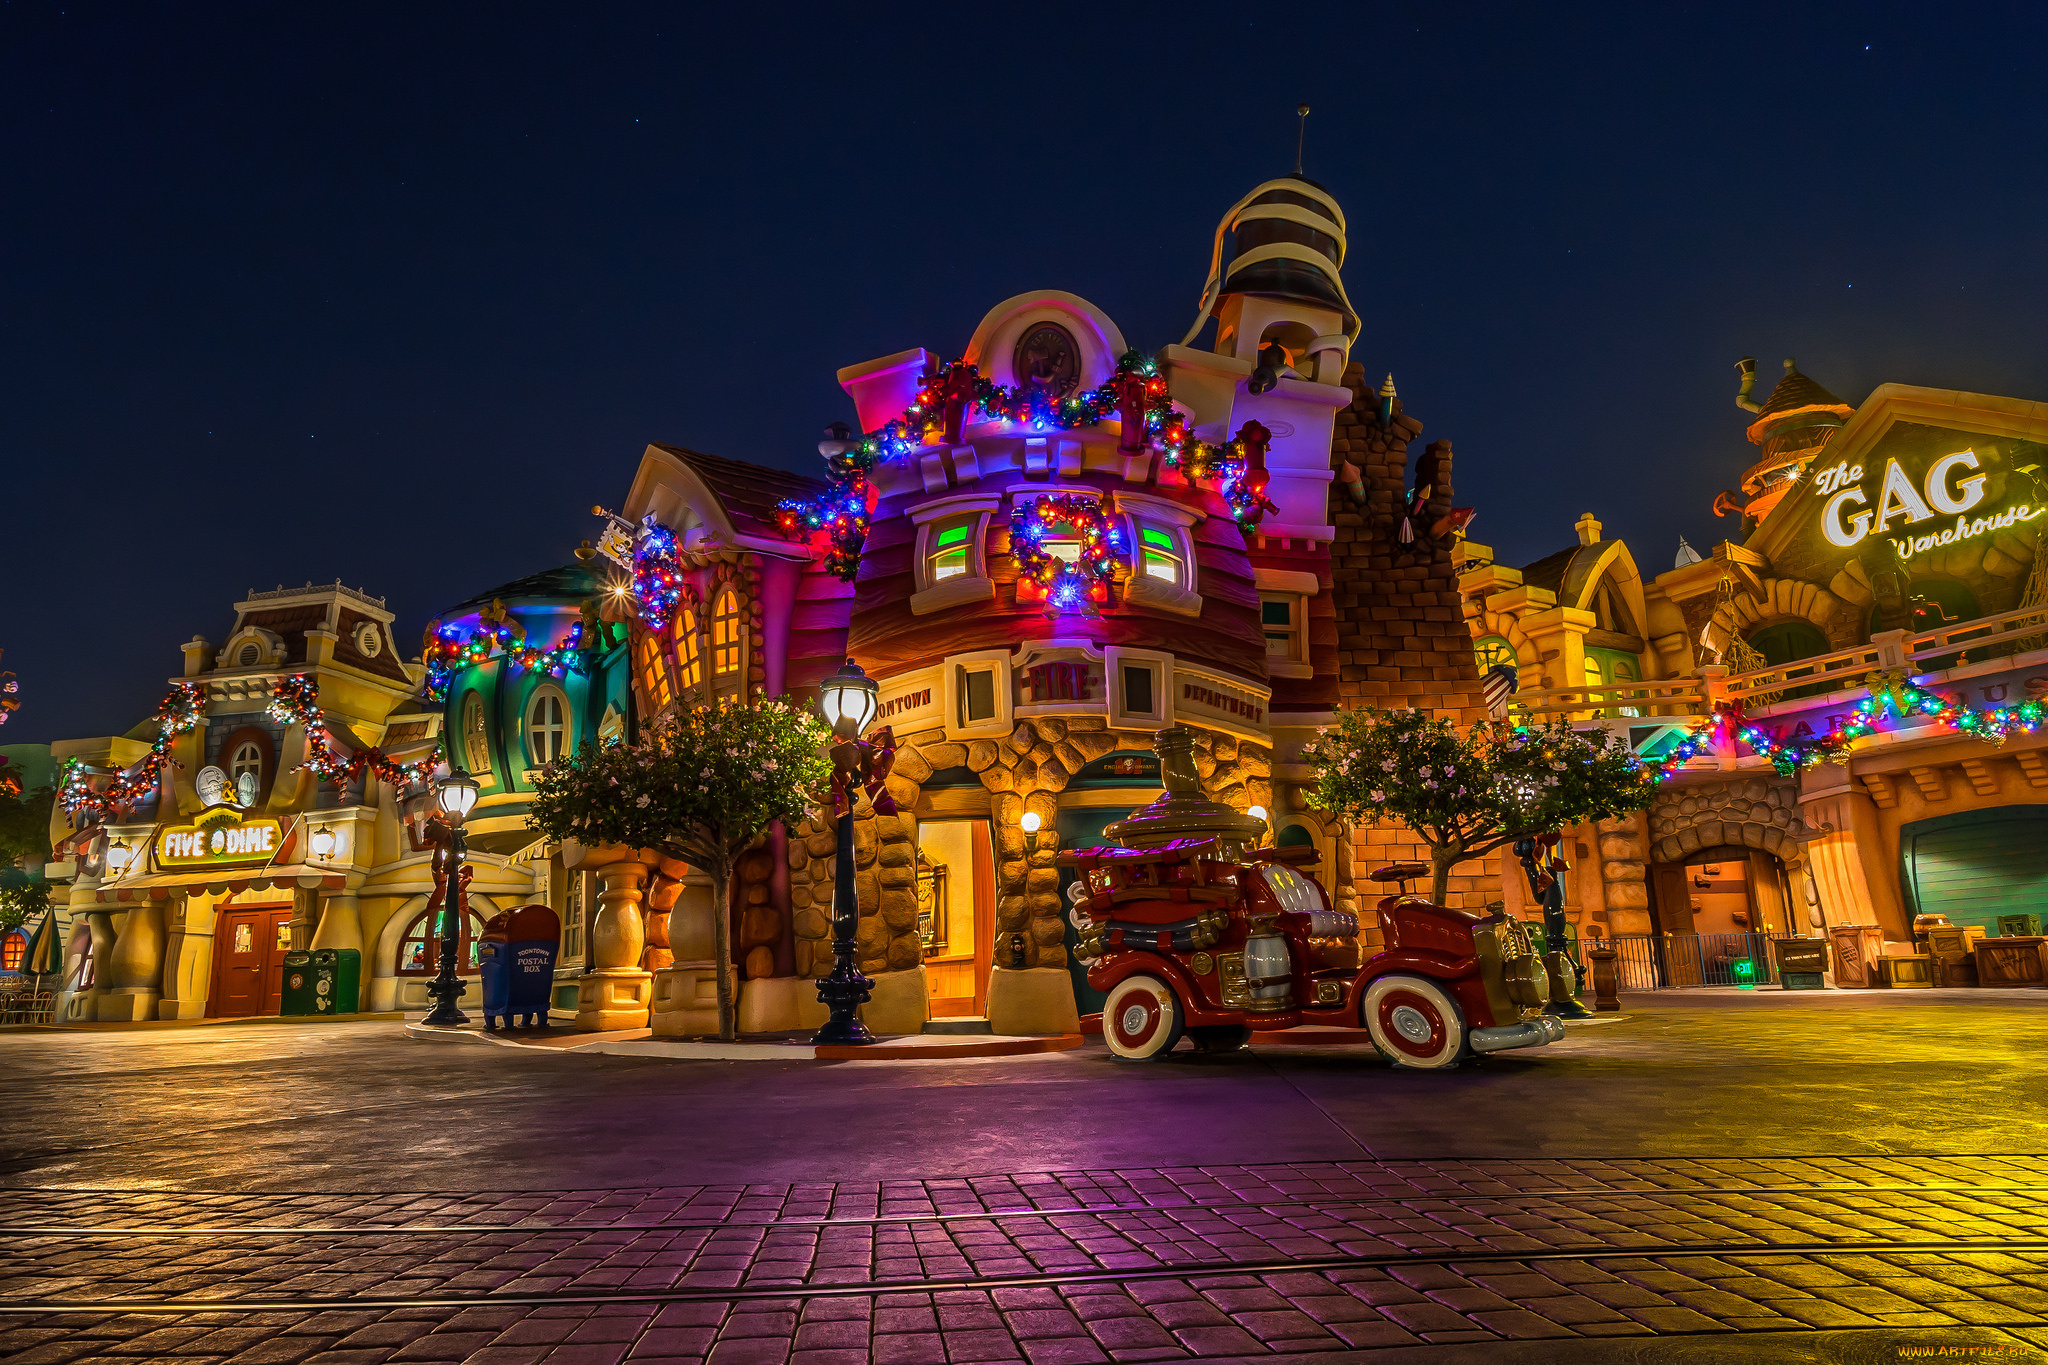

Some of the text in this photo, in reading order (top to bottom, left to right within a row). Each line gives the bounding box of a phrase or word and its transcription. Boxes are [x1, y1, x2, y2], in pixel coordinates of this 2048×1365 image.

[1815, 460, 1864, 495] The
[1821, 447, 1987, 547] GAG
[1887, 504, 2046, 559] Warehouse
[872, 661, 1263, 724] ONTOWN FIRE DEPARTMENT
[165, 826, 274, 857] FIVE DIME
[517, 948, 550, 957] TOONTOWN
[517, 957, 549, 966] POSTAL
[524, 965, 541, 973] BOX
